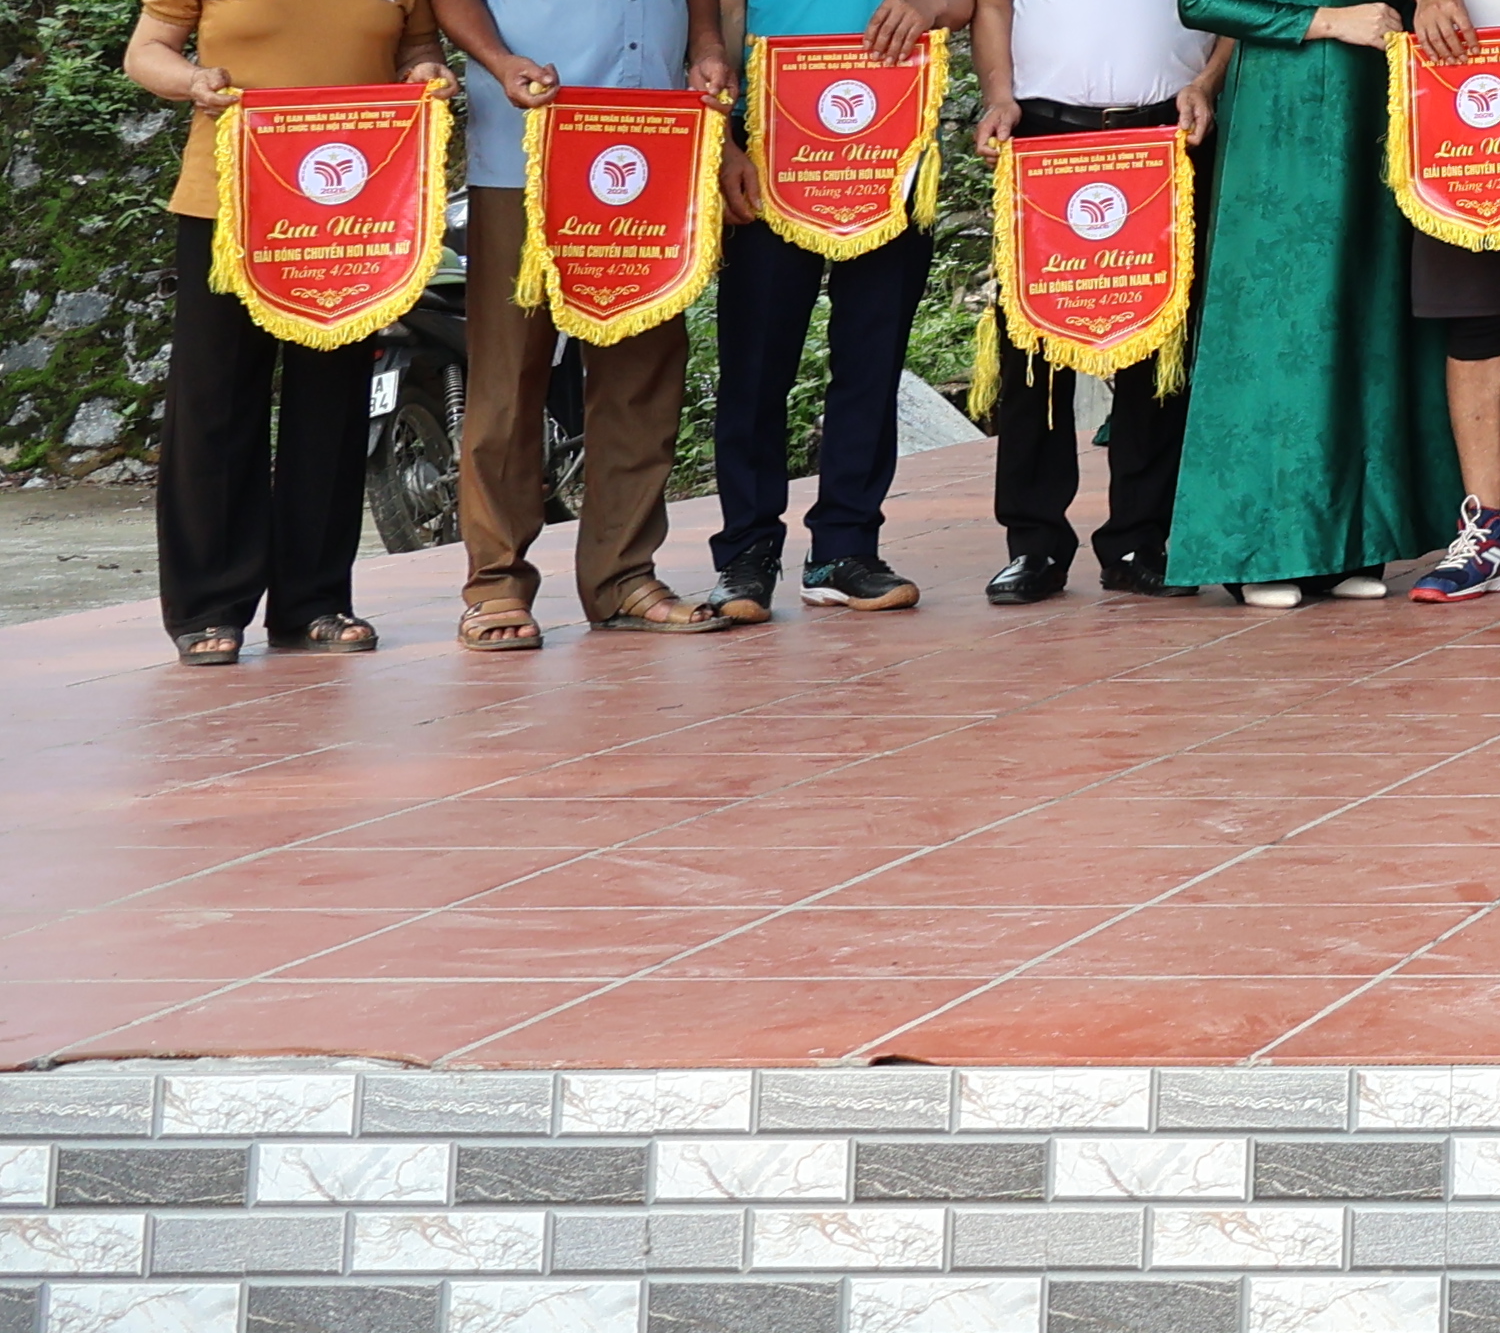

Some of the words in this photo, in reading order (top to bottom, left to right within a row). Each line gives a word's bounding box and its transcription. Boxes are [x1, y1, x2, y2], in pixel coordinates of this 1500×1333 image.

[1447, 180, 1484, 193] Tháng
[281, 266, 326, 281] Tháng
[330, 262, 380, 276] 4/2026
[567, 264, 604, 277] Tháng
[607, 264, 650, 276] 4/2026
